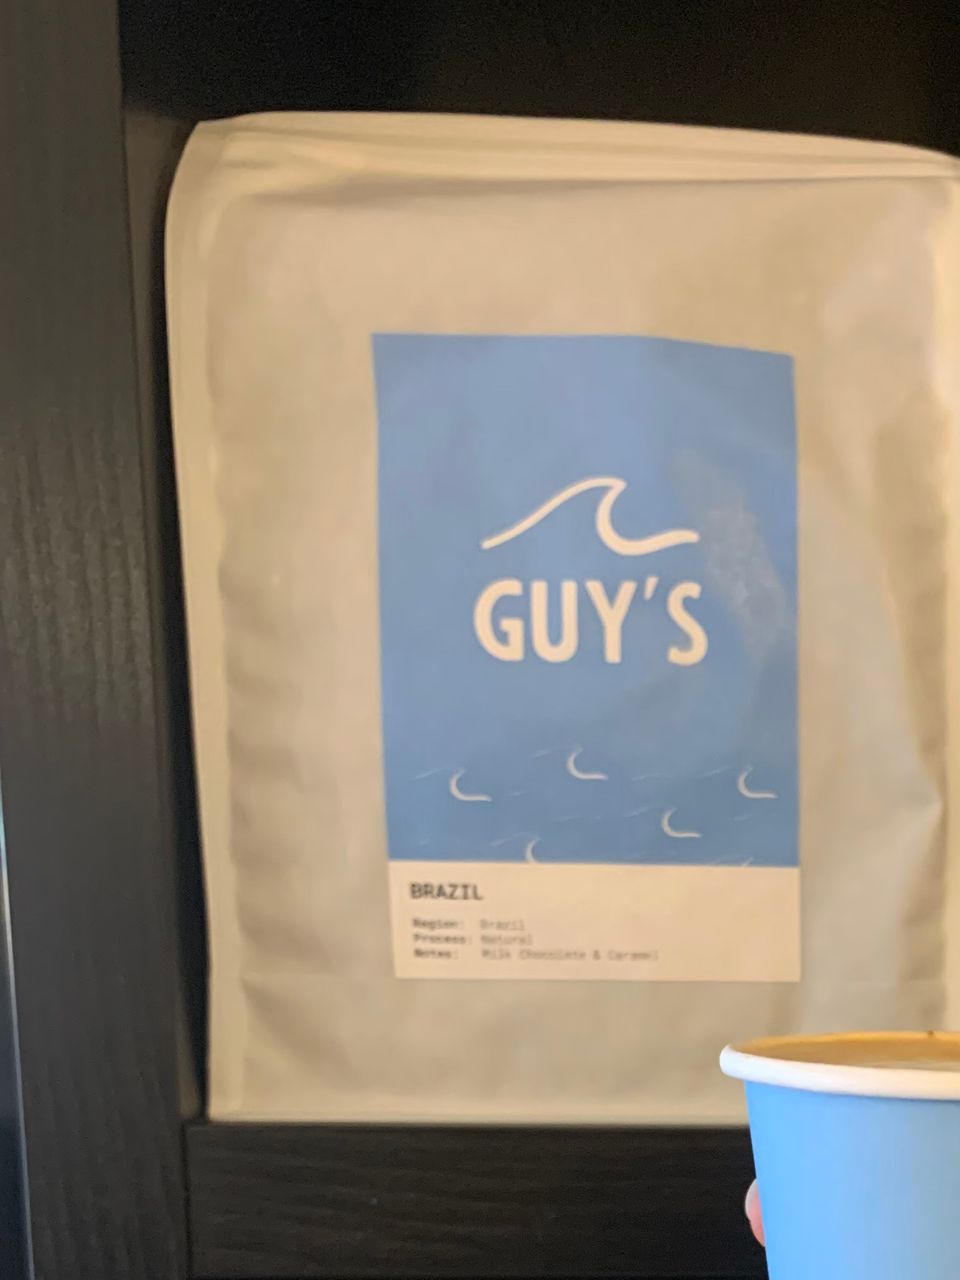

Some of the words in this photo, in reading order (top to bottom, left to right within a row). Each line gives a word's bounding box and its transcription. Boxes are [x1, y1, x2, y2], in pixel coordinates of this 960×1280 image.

[473, 576, 708, 666] GUY'S
[410, 882, 483, 900] BRAZIL
[413, 919, 465, 931] Region:
[480, 919, 525, 930] Brazil
[413, 933, 472, 944] Process:
[480, 934, 532, 945] Natural
[414, 948, 460, 960] Notes:
[481, 949, 511, 960] Milk
[519, 949, 586, 961] Chocolate
[607, 949, 659, 962] Caramel
